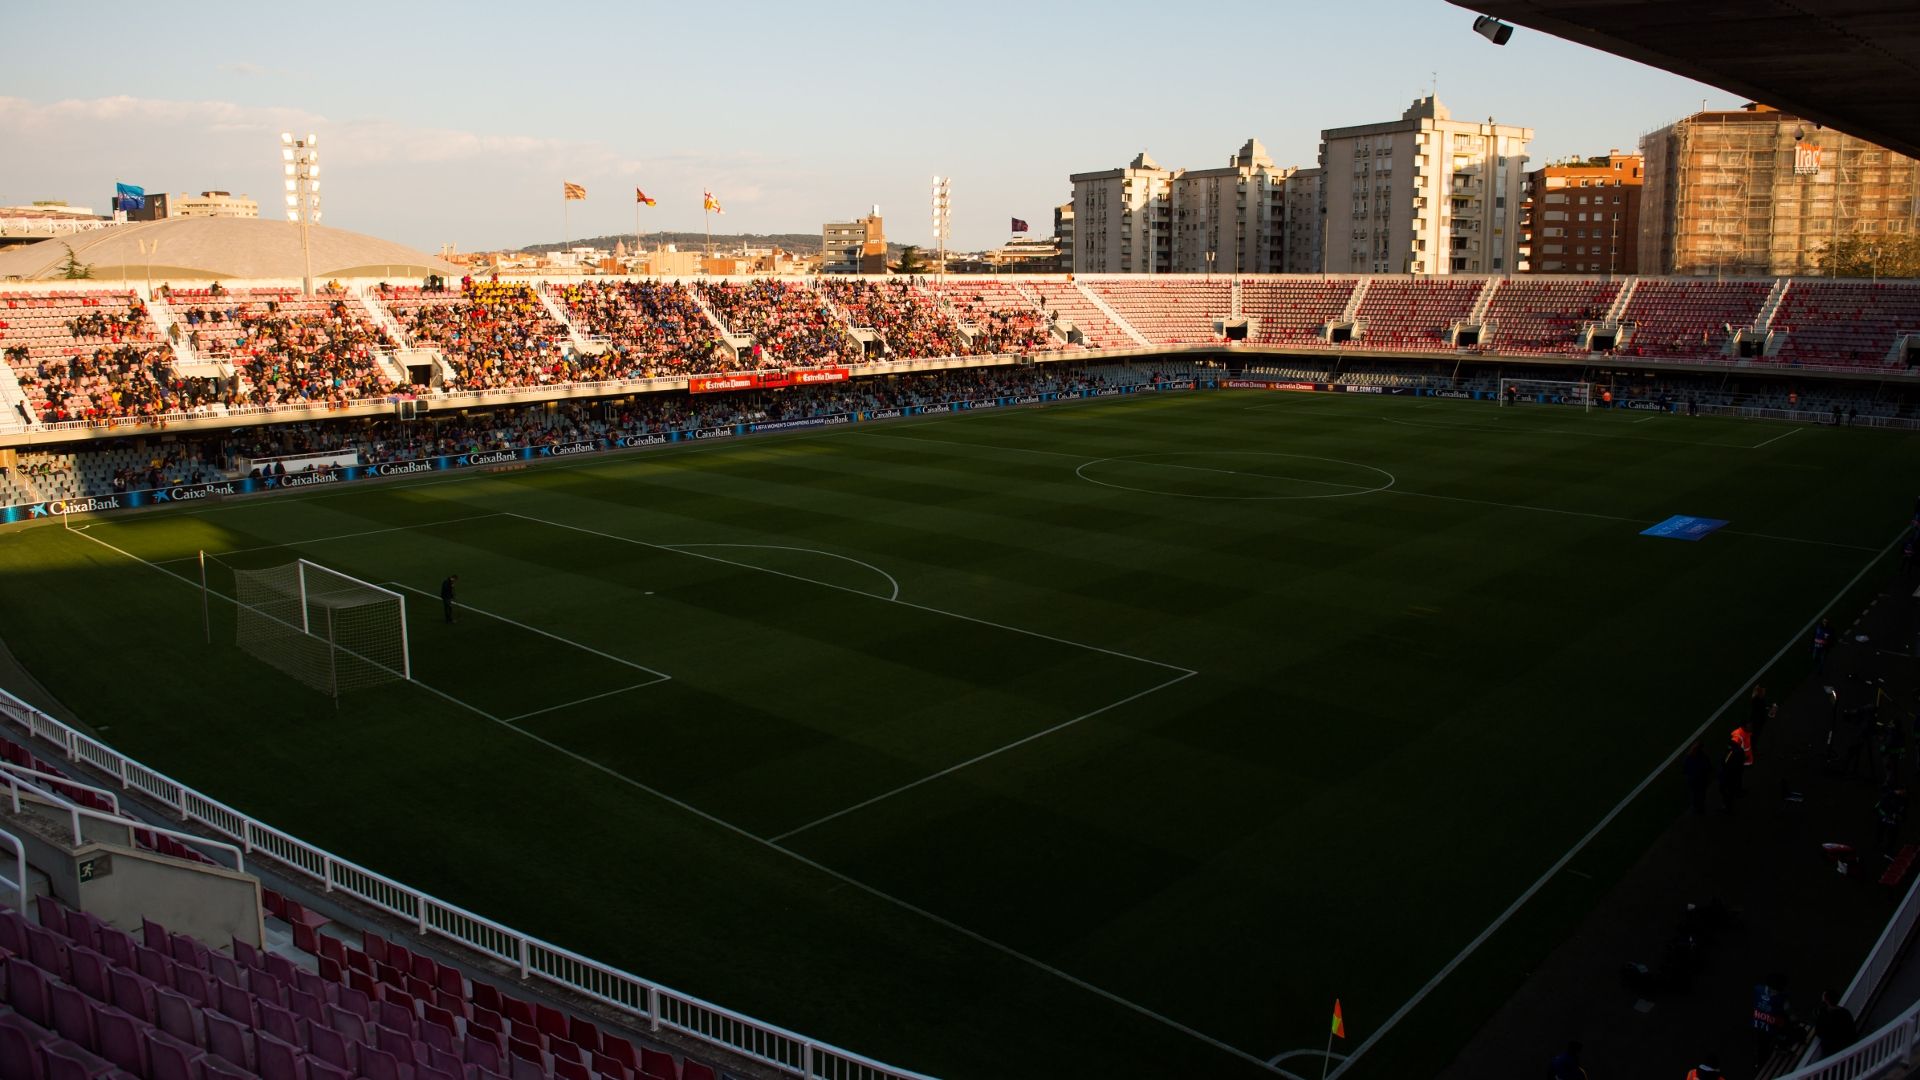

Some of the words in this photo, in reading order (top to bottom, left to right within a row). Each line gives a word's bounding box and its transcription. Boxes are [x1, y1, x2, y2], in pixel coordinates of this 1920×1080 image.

[706, 381, 730, 389] Estrella
[730, 379, 750, 388] Damm
[695, 427, 732, 440] CaixaBank
[627, 435, 666, 447] CaixaBank
[552, 441, 595, 456] CaixaBank
[470, 452, 517, 465] CaixaBank
[380, 460, 432, 475] CaixaBank
[281, 472, 338, 488] CaixaBank
